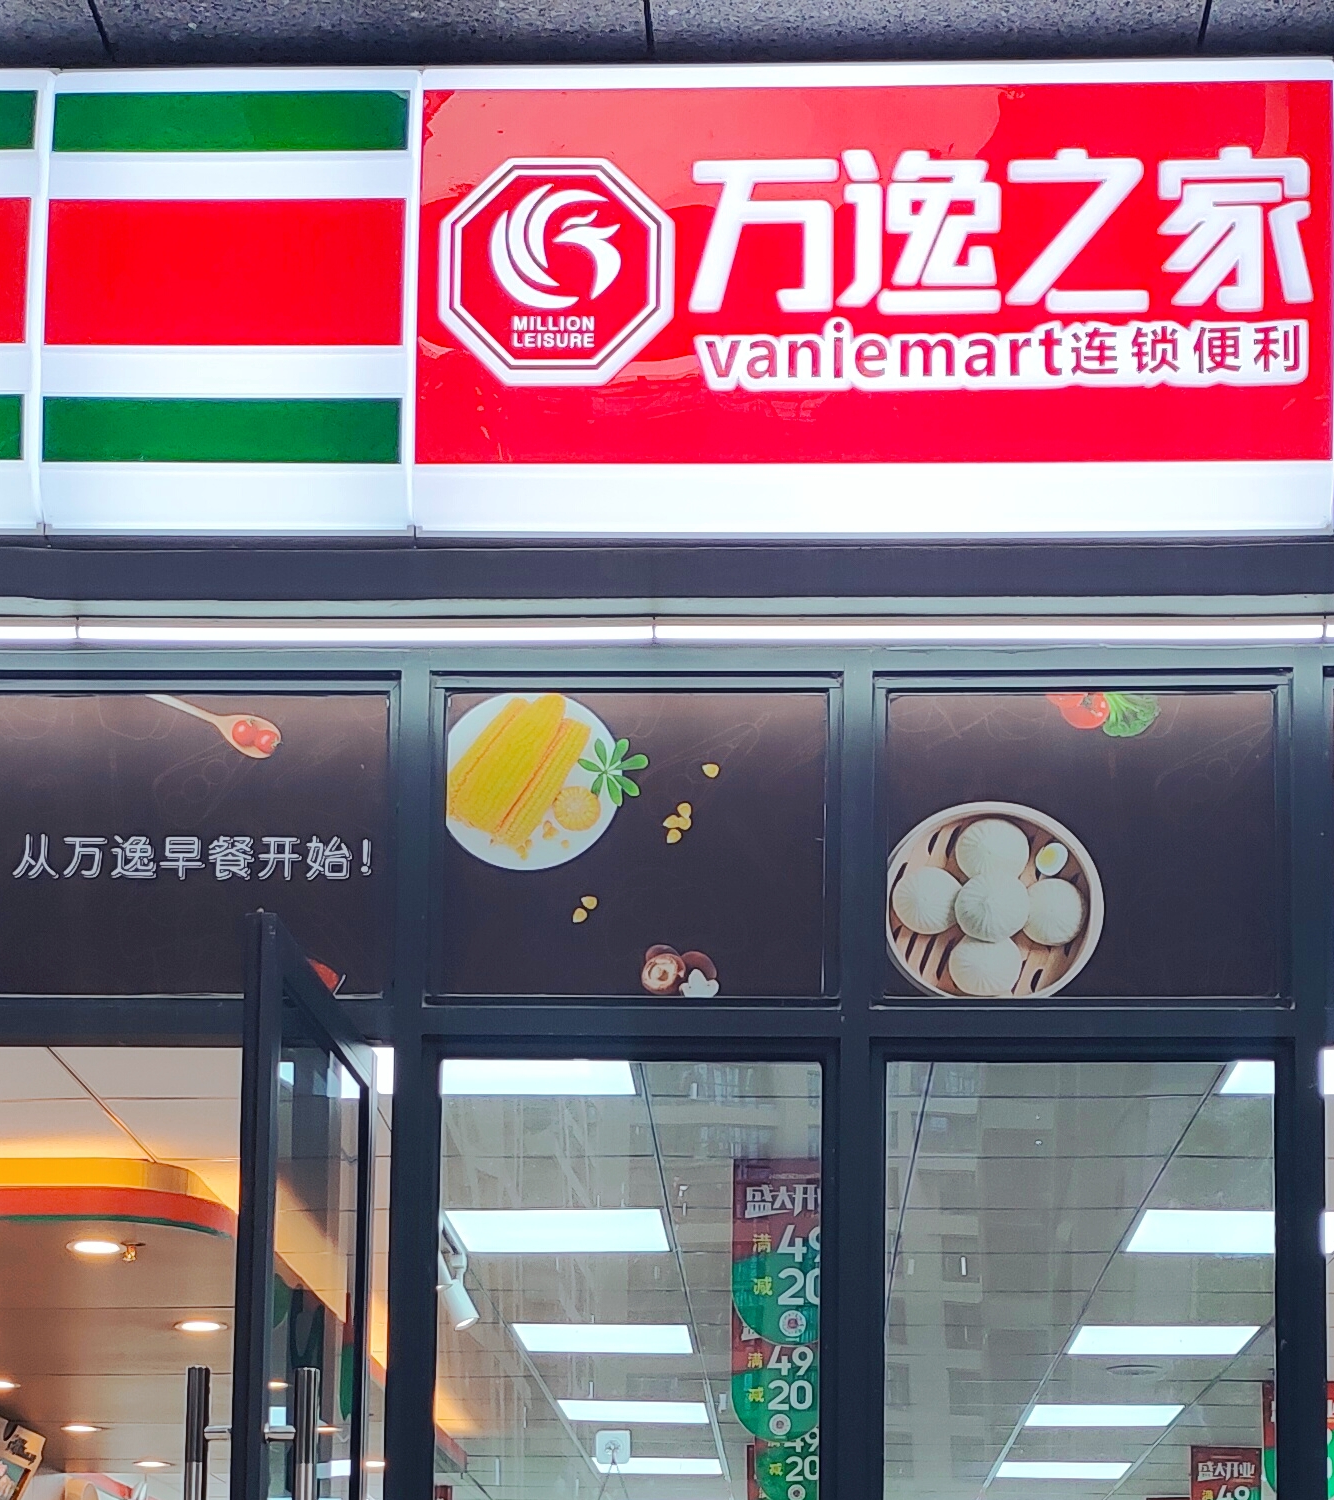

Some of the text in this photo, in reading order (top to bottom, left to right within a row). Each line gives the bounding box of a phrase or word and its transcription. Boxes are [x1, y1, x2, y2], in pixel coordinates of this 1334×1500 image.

[687, 146, 1314, 316] 万逸之家
[512, 316, 595, 332] MILLION
[512, 332, 595, 349] LEISURE
[705, 321, 1302, 381] vaniemart 连锁便利
[1197, 1461, 1255, 1481] 盛大开业
